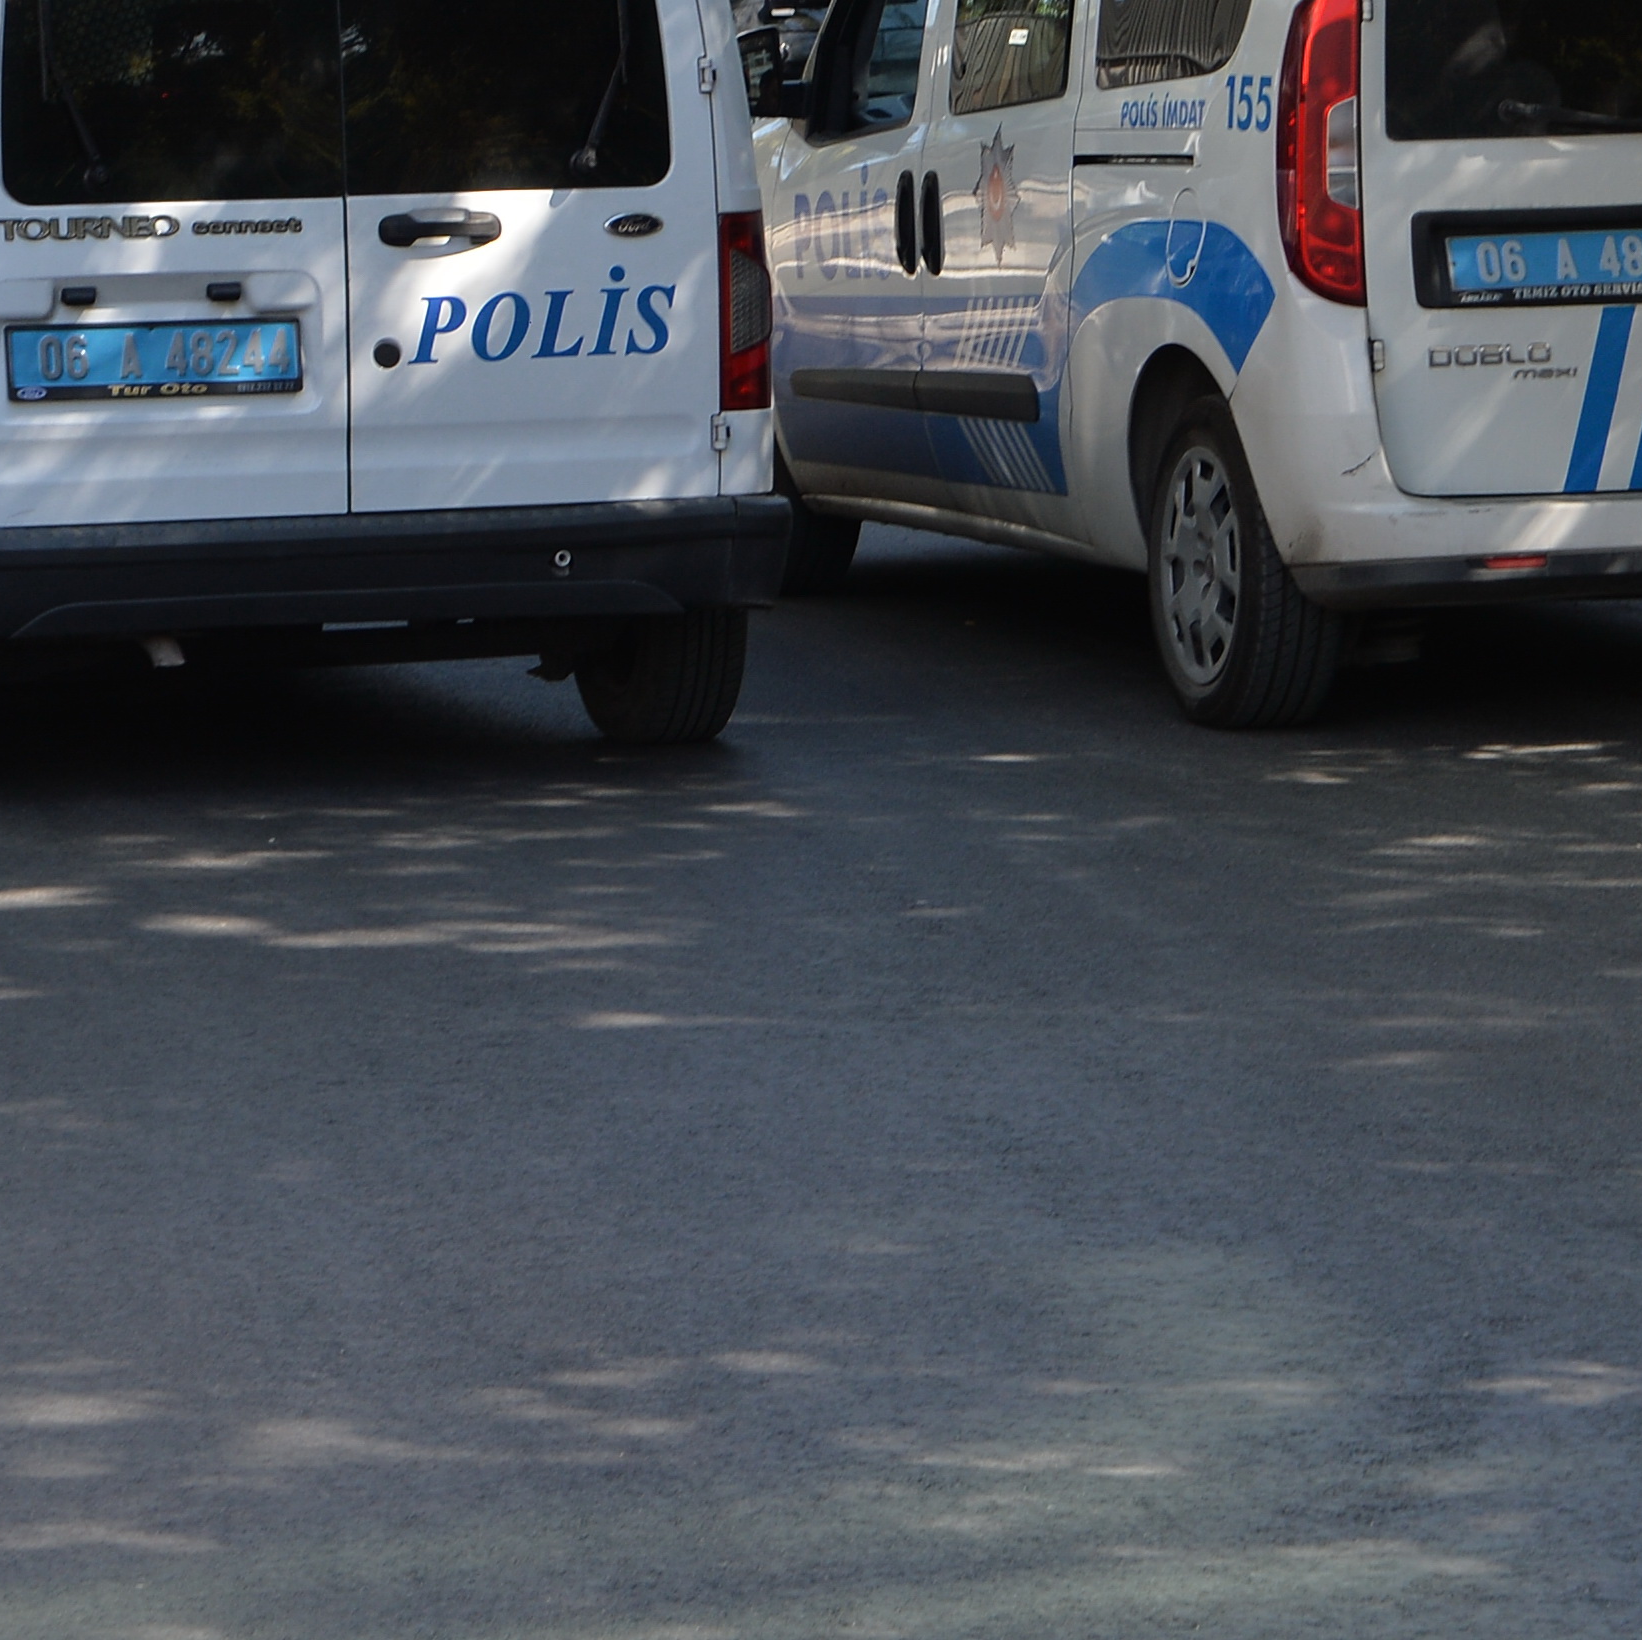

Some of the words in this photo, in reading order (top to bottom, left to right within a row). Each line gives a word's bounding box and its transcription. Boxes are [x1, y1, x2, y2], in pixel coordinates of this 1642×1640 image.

[1120, 91, 1158, 129] POLİS
[1162, 91, 1205, 129] İMDAT
[1225, 73, 1273, 133] 155
[191, 217, 303, 236] connect
[1475, 238, 1527, 285] 06
[1557, 237, 1579, 281] A
[407, 264, 677, 366] POLİS
[37, 333, 90, 381] 06
[119, 332, 143, 379] A
[164, 327, 291, 378] 48244
[1428, 340, 1553, 370] DOBLO
[108, 383, 152, 398] Tur
[160, 382, 208, 396] Oto
